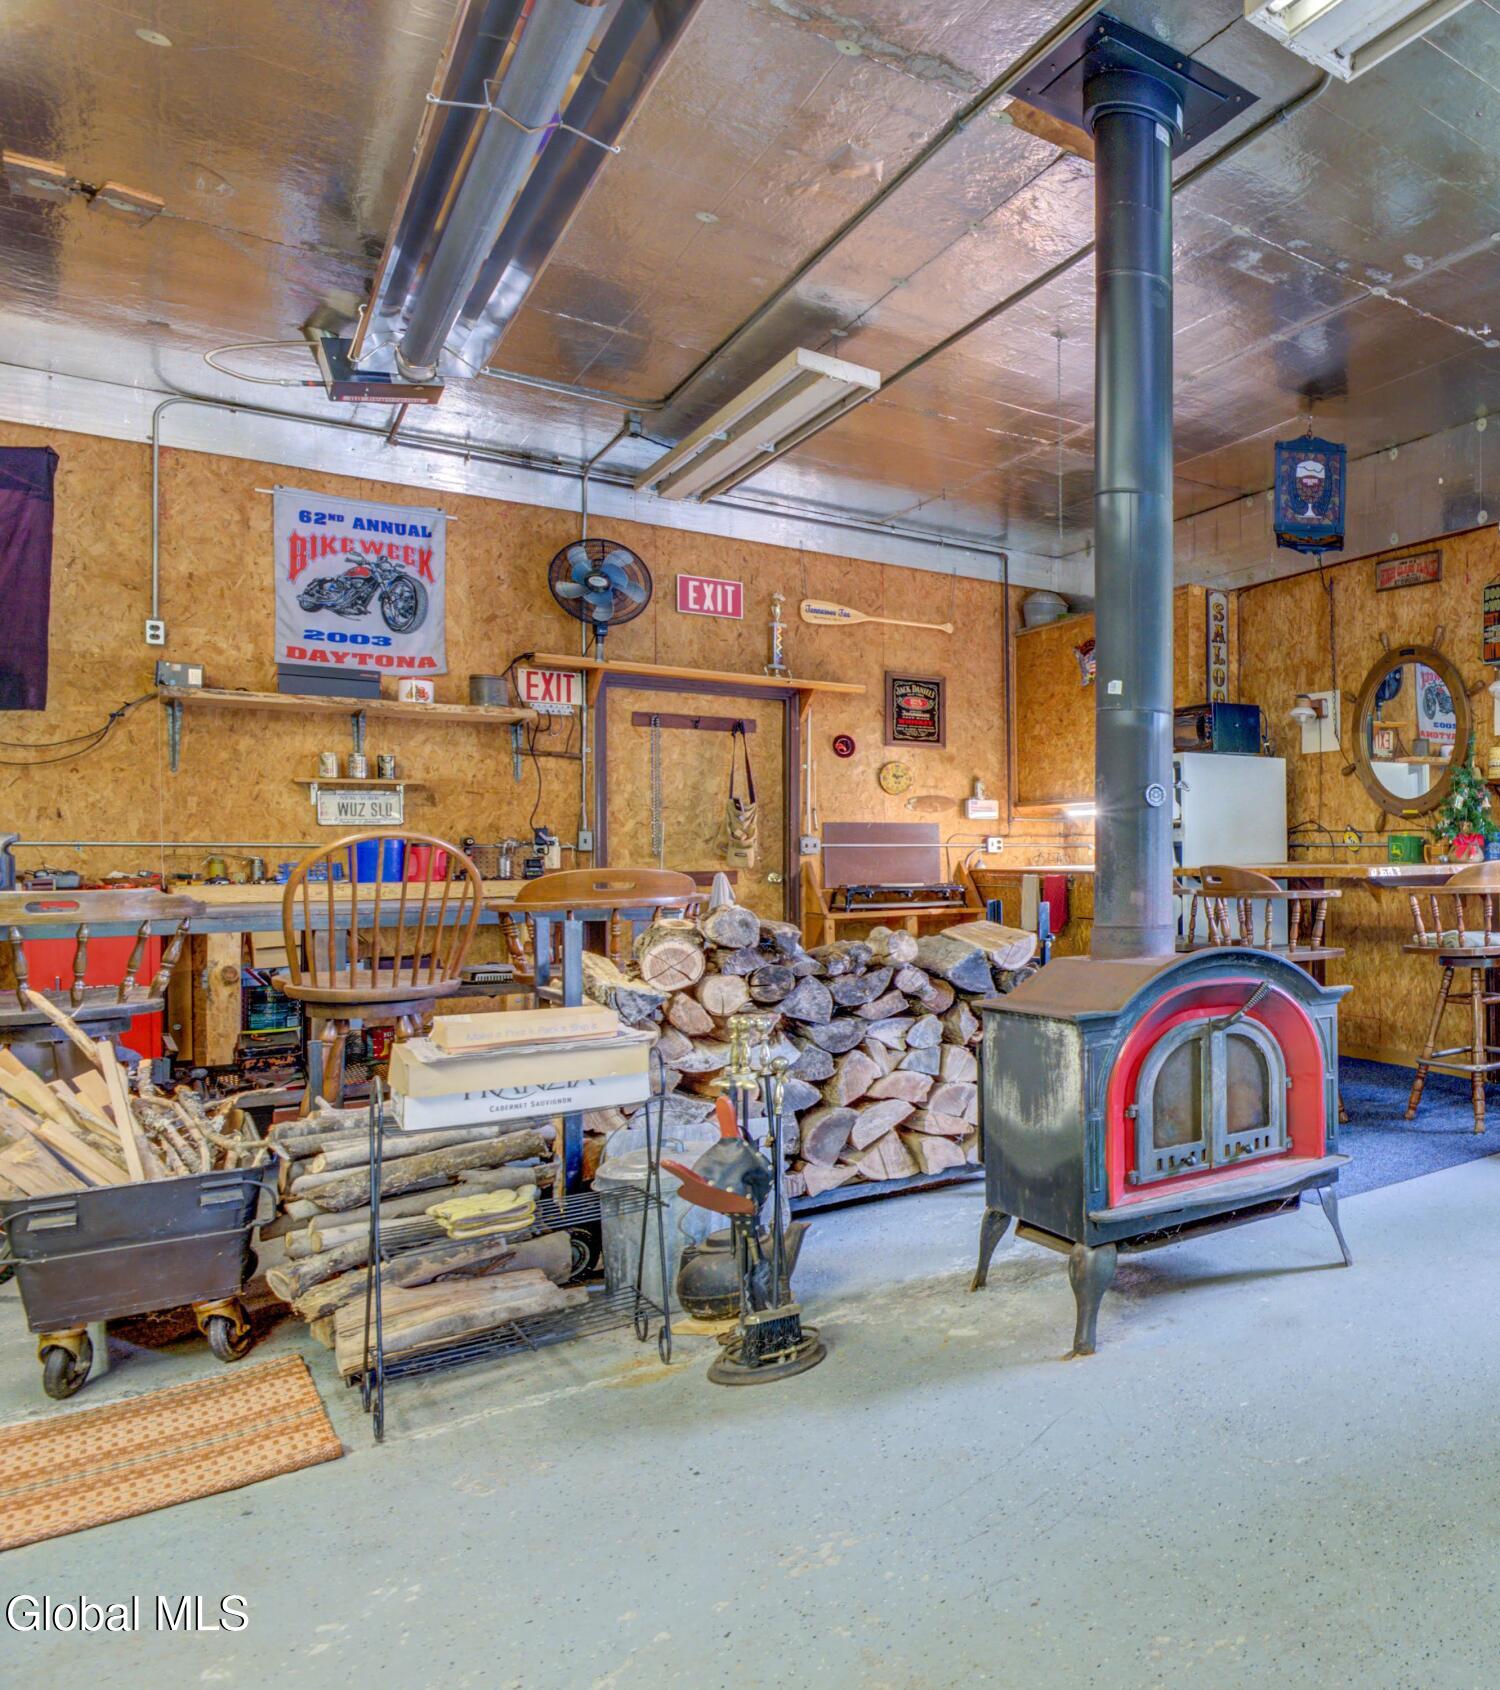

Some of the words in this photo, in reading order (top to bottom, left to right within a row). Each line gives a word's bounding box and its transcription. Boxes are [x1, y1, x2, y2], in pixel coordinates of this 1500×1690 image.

[298, 510, 345, 526] 62ND
[352, 517, 432, 538] ANNUAL
[288, 529, 355, 584] BIKE
[360, 538, 436, 584] WEEK
[688, 580, 736, 615] EXIT
[303, 629, 392, 647] 2003
[286, 645, 438, 669] DAYTONA
[1212, 602, 1226, 704] SALOO
[526, 670, 576, 704] EXIT
[896, 685, 911, 696] JACK
[337, 802, 366, 817] WUZ
[489, 1101, 528, 1113] CABERNET
[530, 1097, 573, 1108] SAUVIGNON
